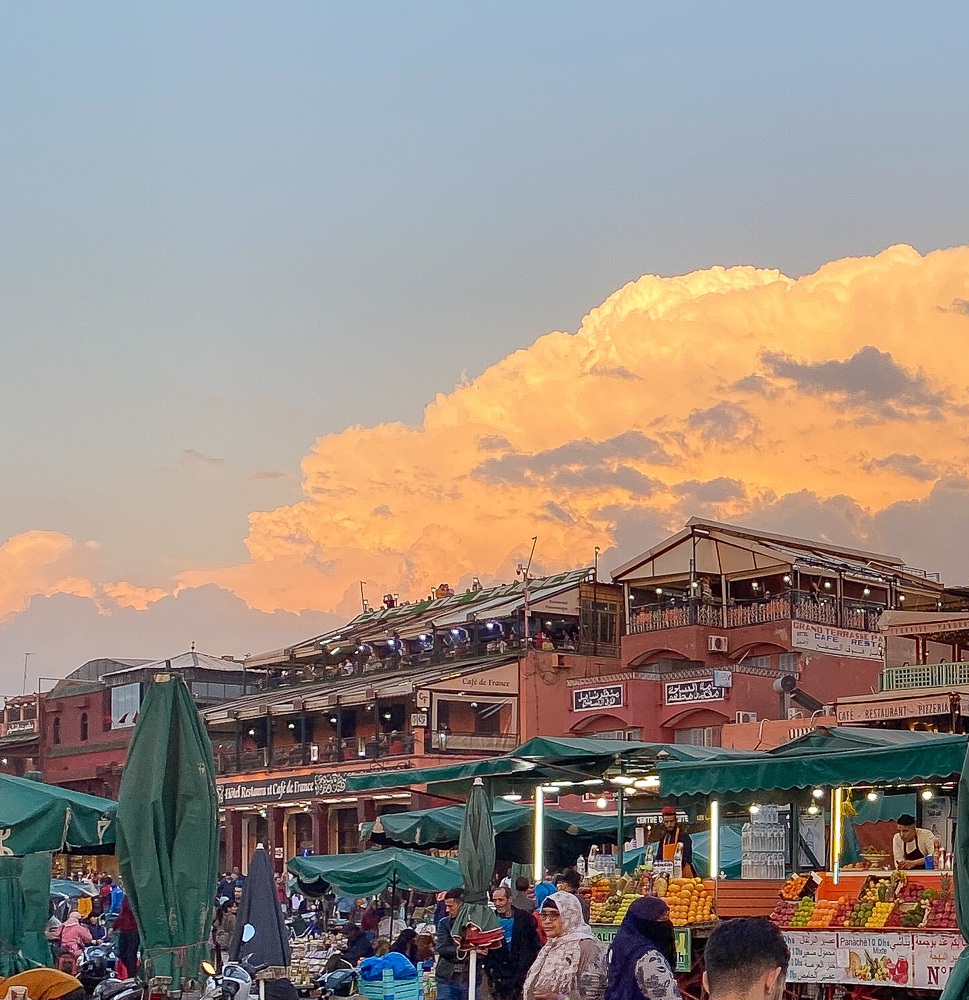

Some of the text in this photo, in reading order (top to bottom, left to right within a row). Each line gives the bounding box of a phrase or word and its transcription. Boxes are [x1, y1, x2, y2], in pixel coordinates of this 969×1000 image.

[793, 622, 823, 634] GRAND
[825, 628, 869, 640] TERRASSE
[462, 677, 511, 688] Café de France
[865, 706, 908, 719] RESTAURANT
[918, 703, 950, 714] PIZZERIA
[273, 780, 286, 799] Café
[286, 780, 293, 793] de
[294, 781, 314, 793] France
[636, 816, 658, 825] CENTRE
[840, 937, 868, 947] Panaché
[868, 938, 876, 947] 10
